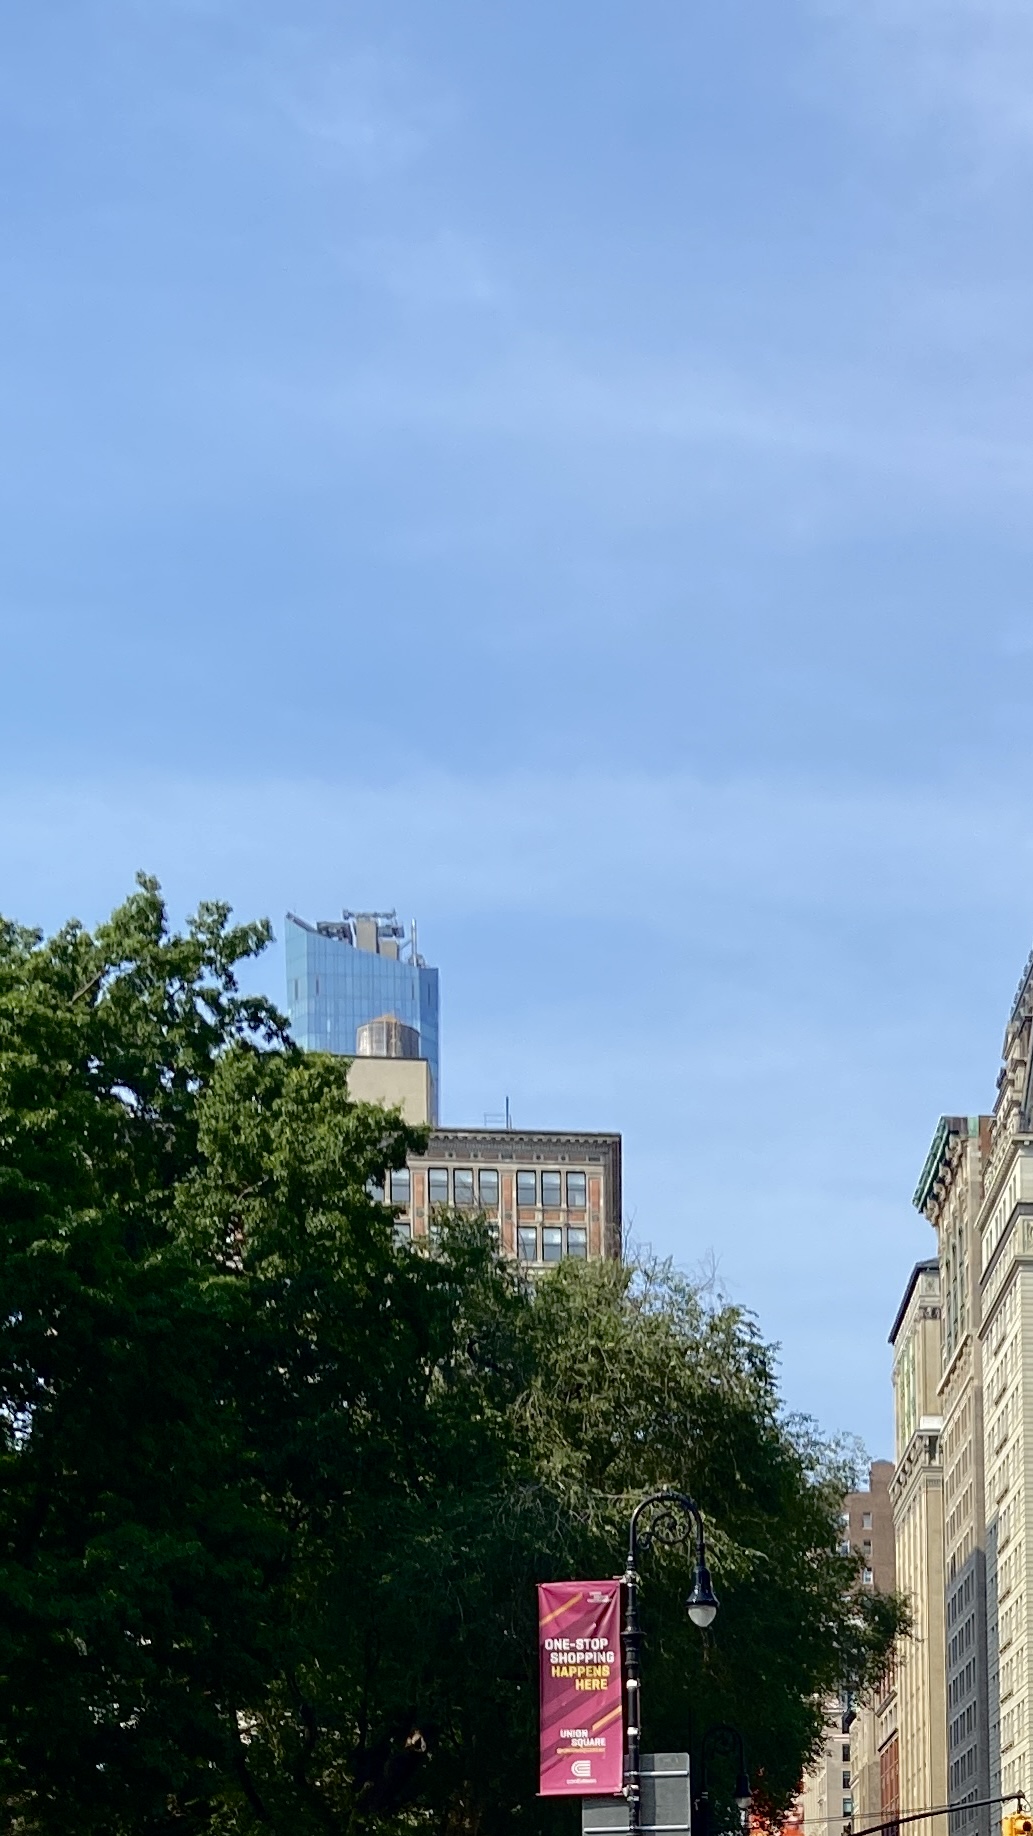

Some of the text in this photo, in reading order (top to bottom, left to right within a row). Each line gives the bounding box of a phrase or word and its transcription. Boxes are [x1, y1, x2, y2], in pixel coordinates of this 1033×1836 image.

[544, 1638, 609, 1651] ONE-STOP
[550, 1651, 615, 1664] SHOPPING
[551, 1665, 610, 1678] HAPPENS
[575, 1678, 608, 1690] HERE
[560, 1728, 588, 1738] UNION
[571, 1737, 606, 1748] SQUARE
